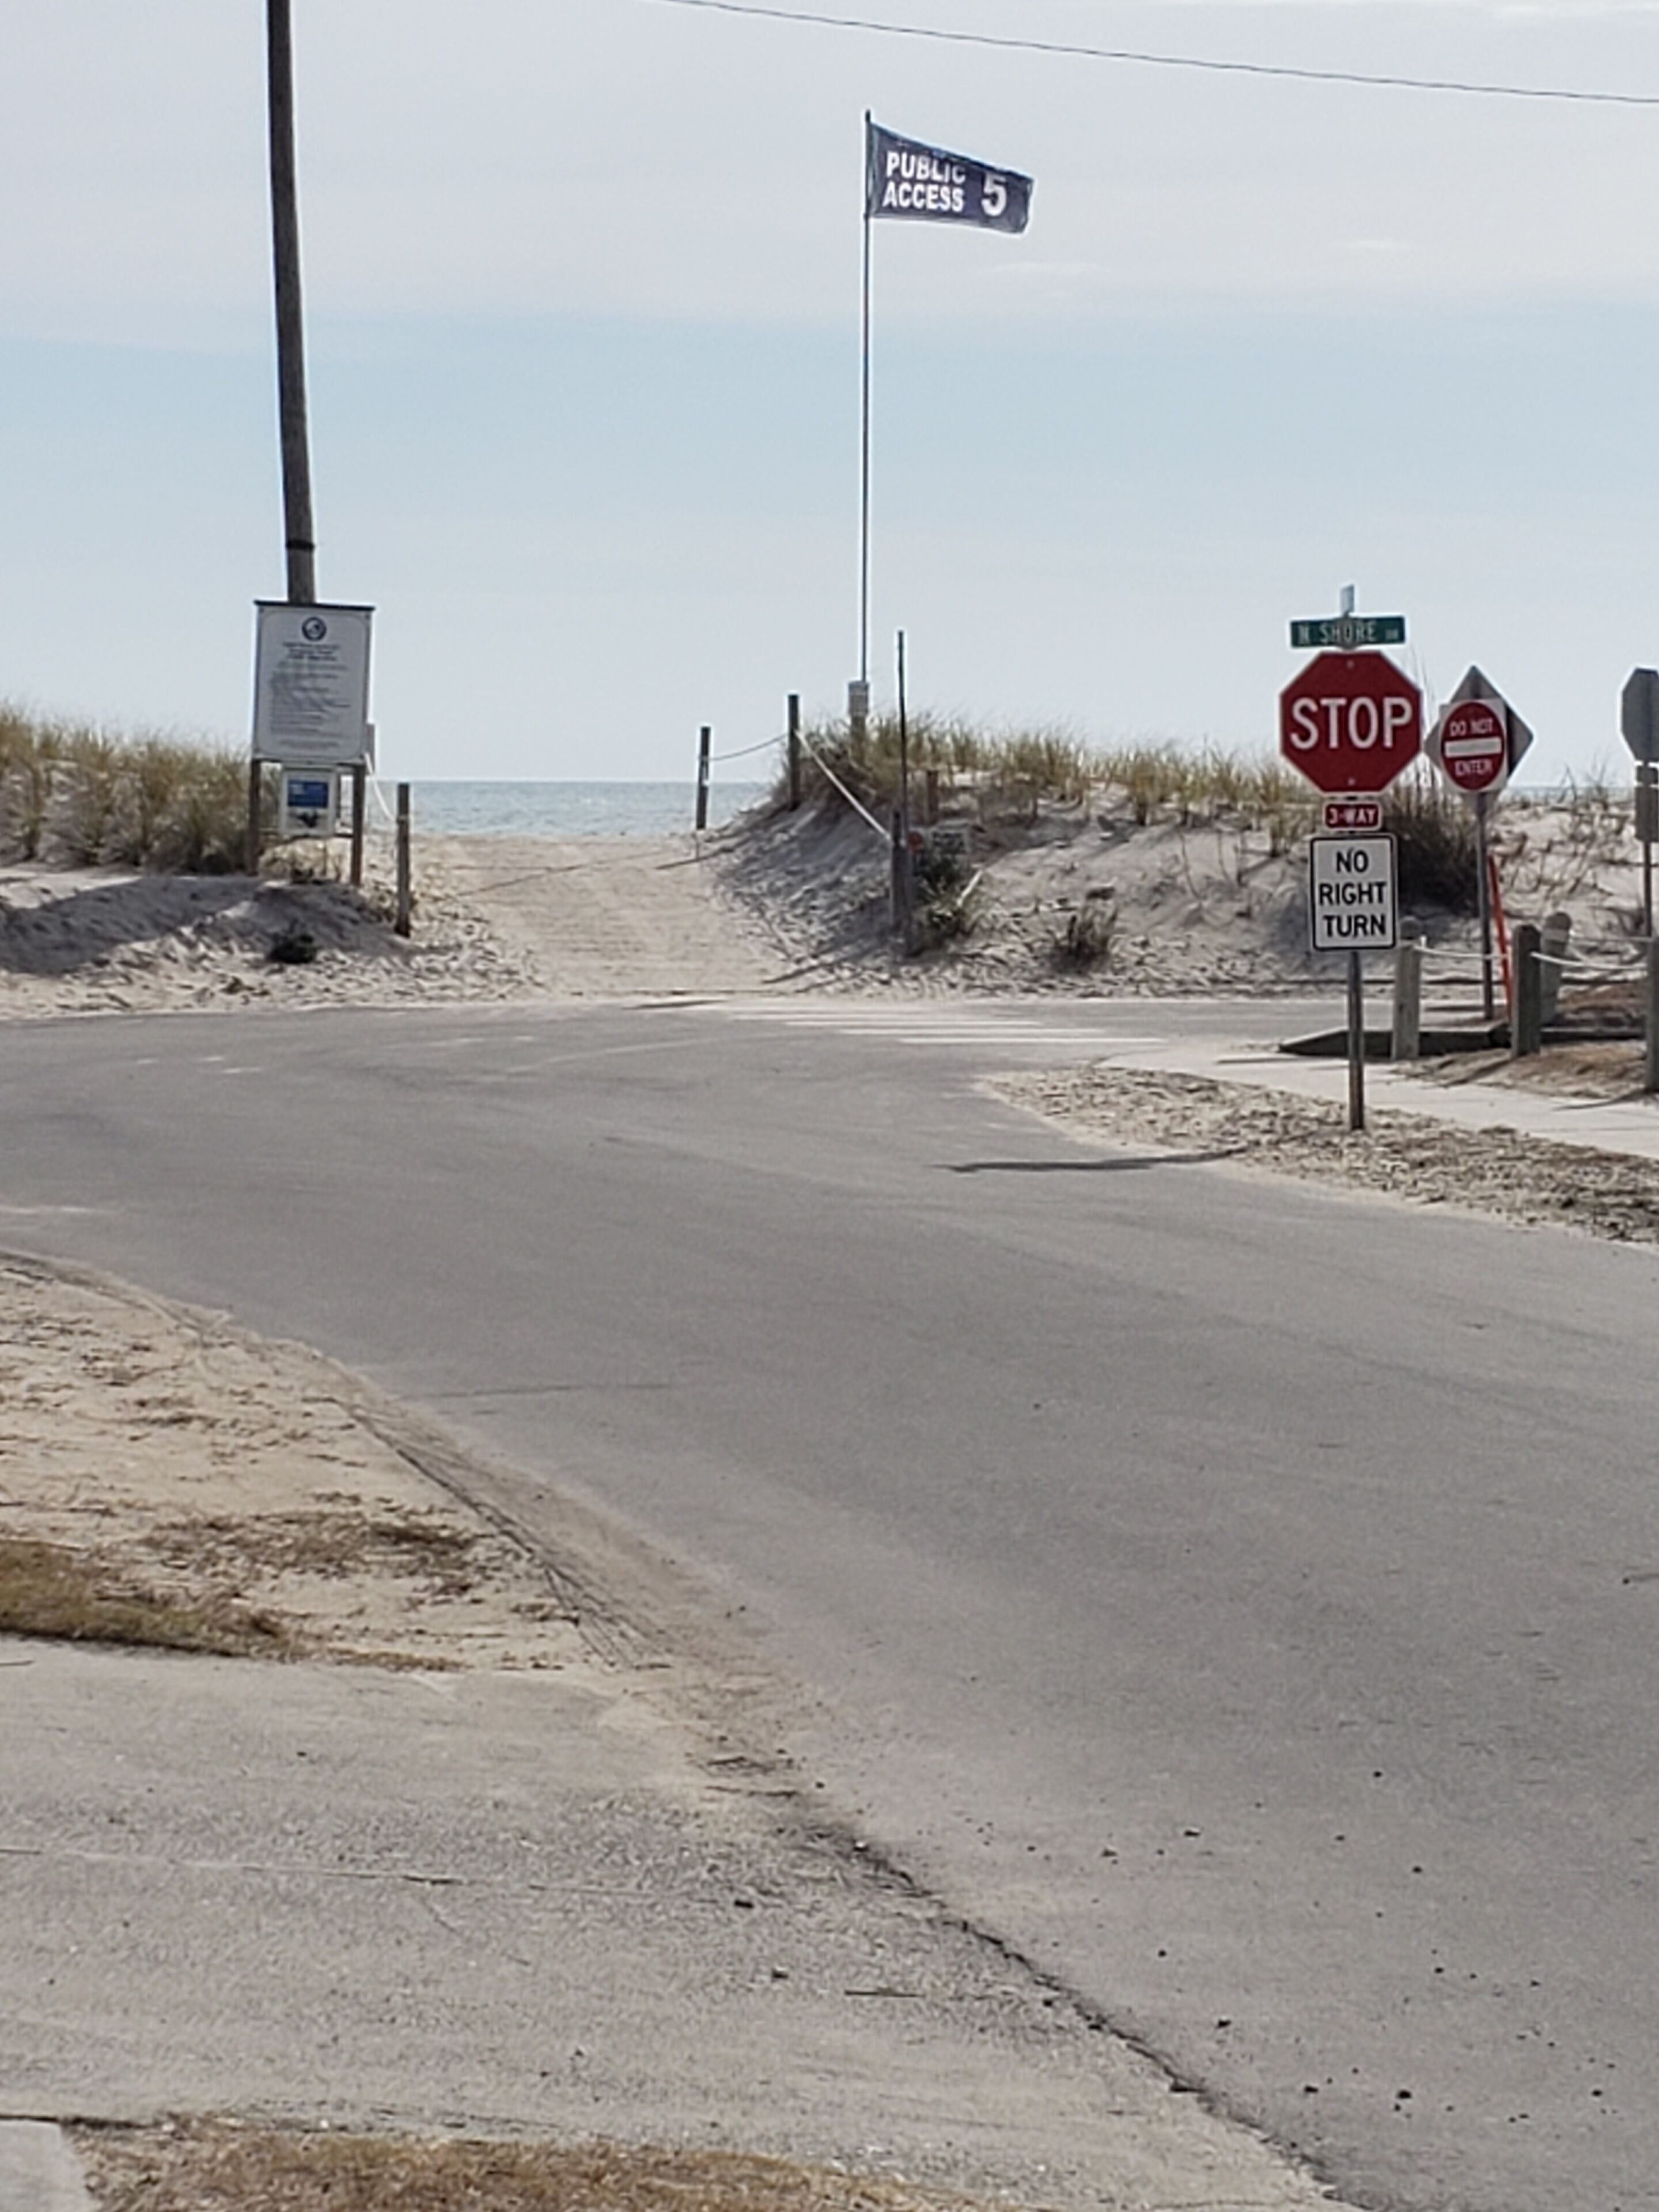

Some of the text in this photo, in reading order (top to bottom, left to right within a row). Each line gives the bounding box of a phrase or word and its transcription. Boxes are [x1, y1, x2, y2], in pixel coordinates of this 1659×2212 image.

[885, 151, 965, 184] PUBLIC
[882, 172, 1007, 217] ACCESS 5
[1290, 696, 1412, 749] STOP
[1328, 809, 1377, 824] 3-WAY
[1336, 850, 1369, 873] NO
[1319, 881, 1387, 906] RIGHT
[1323, 914, 1386, 938] TURN
